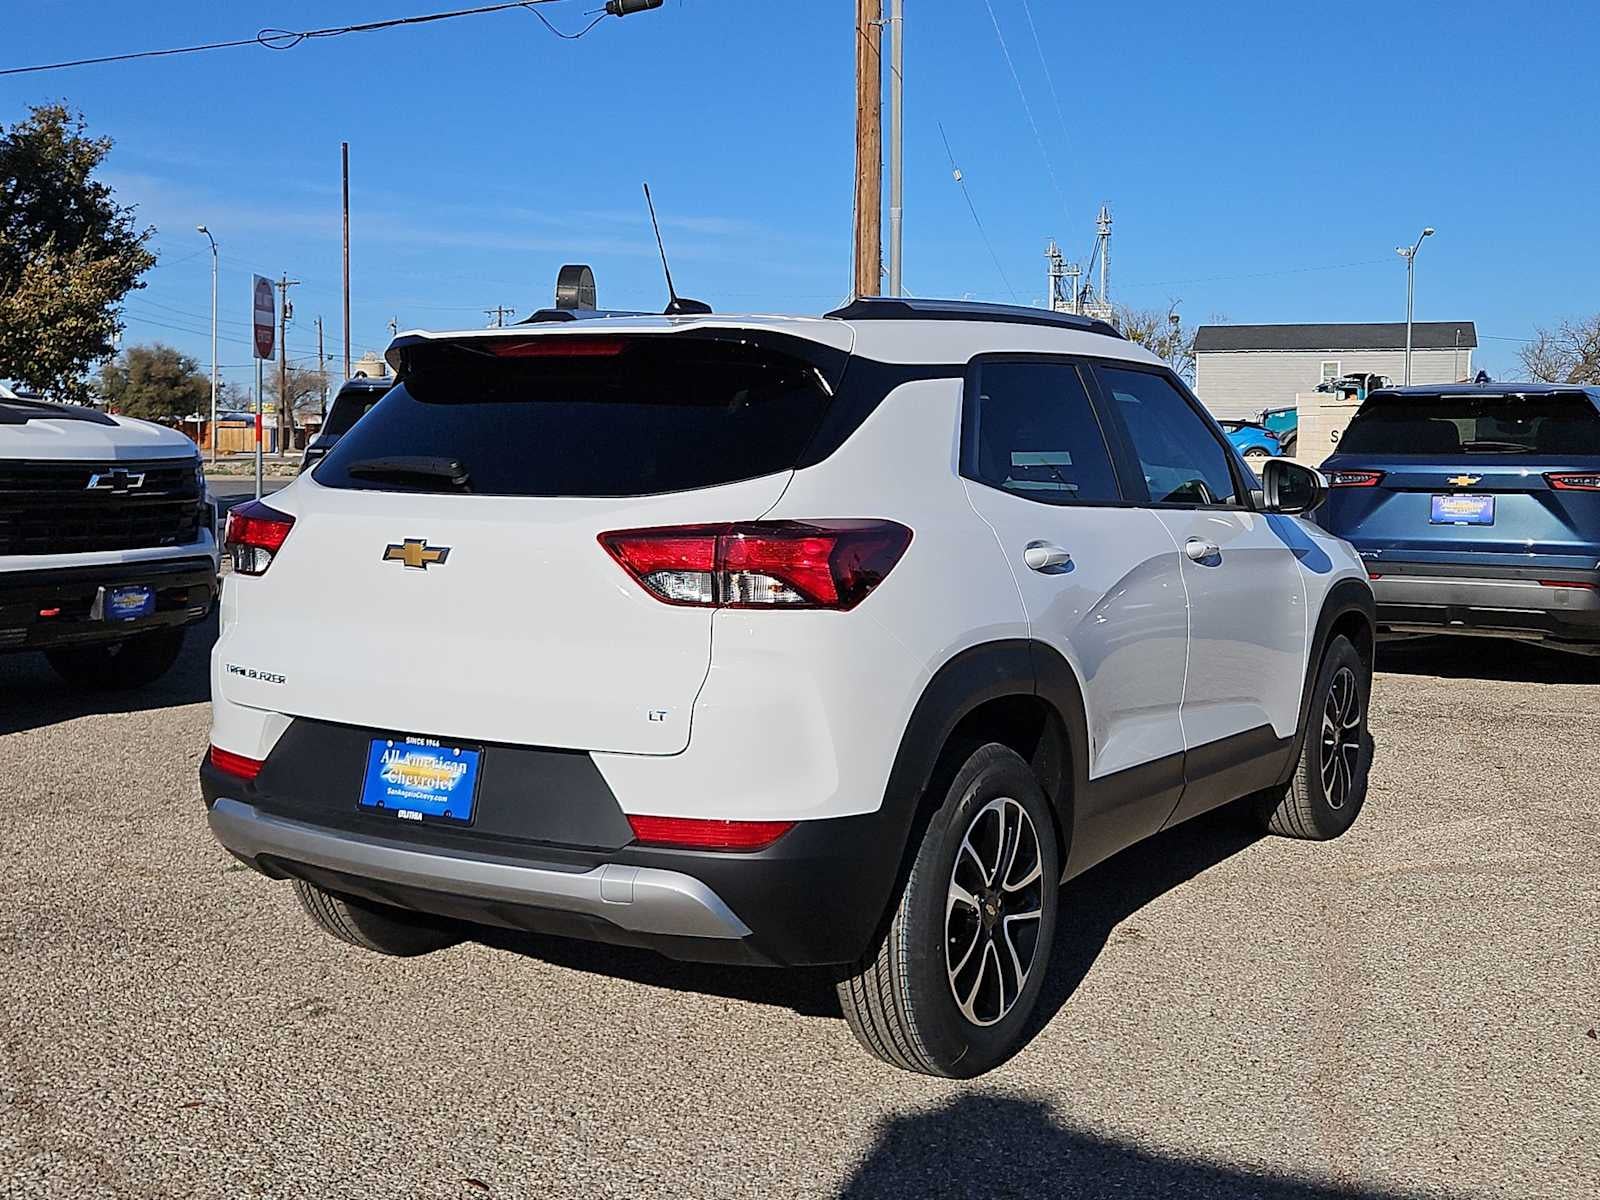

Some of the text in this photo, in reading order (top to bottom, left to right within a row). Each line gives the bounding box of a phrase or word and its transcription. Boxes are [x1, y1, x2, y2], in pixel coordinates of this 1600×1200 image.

[225, 664, 286, 684] TRAILBLAZER
[649, 710, 667, 721] LT
[405, 736, 425, 746] SINCE
[380, 749, 467, 774] All American
[387, 768, 454, 791] Chevrolet
